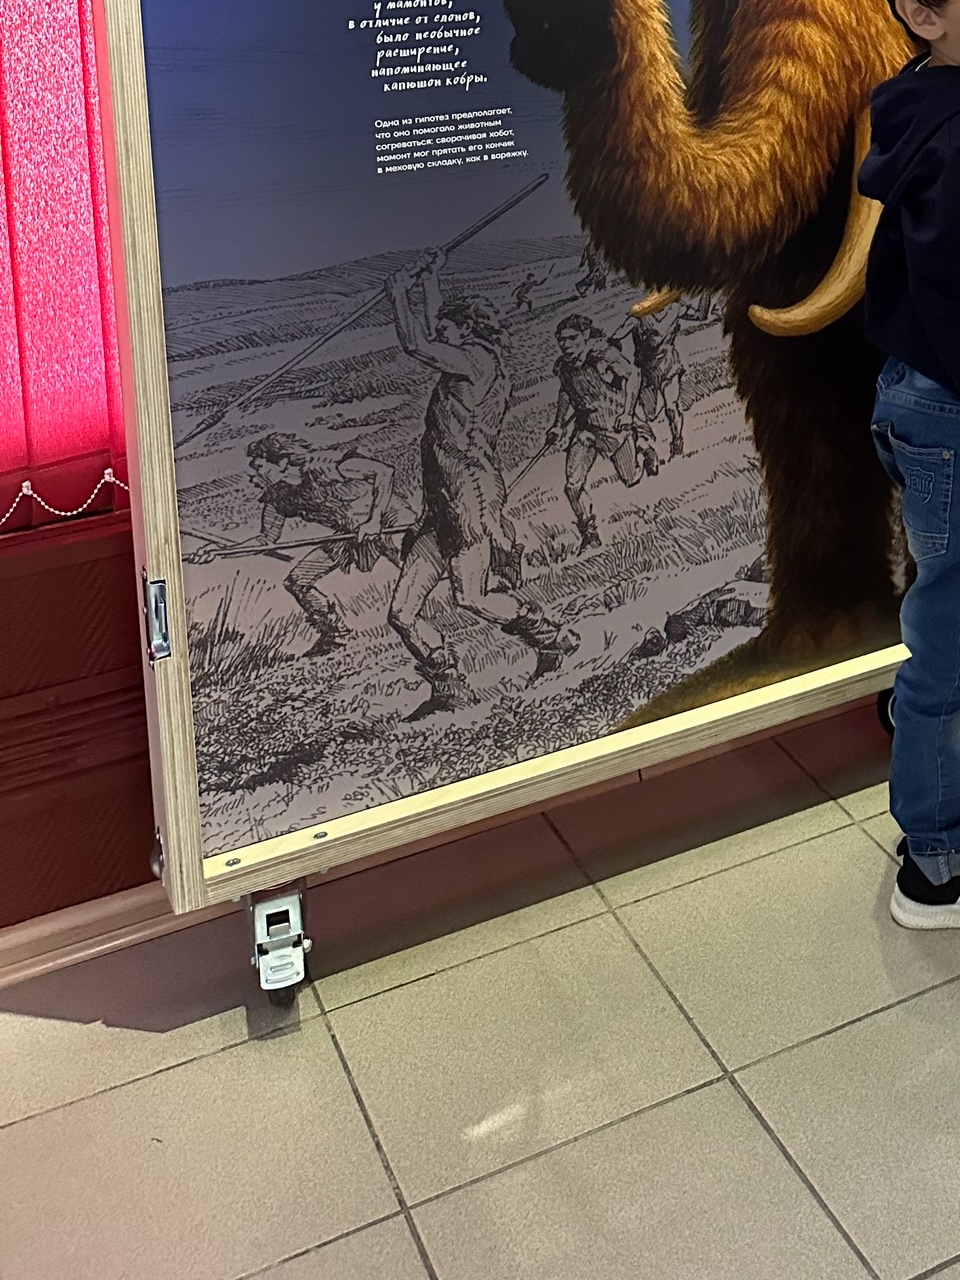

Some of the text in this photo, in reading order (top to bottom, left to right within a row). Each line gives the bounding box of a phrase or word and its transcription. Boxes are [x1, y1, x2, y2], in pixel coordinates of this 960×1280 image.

[374, 2, 381, 18] у
[348, 20, 355, 29] в
[359, 16, 410, 28] отличие
[415, 16, 428, 24] от
[376, 25, 480, 43] было необычное
[371, 60, 467, 77] напоминающее
[383, 78, 441, 91] капюшон
